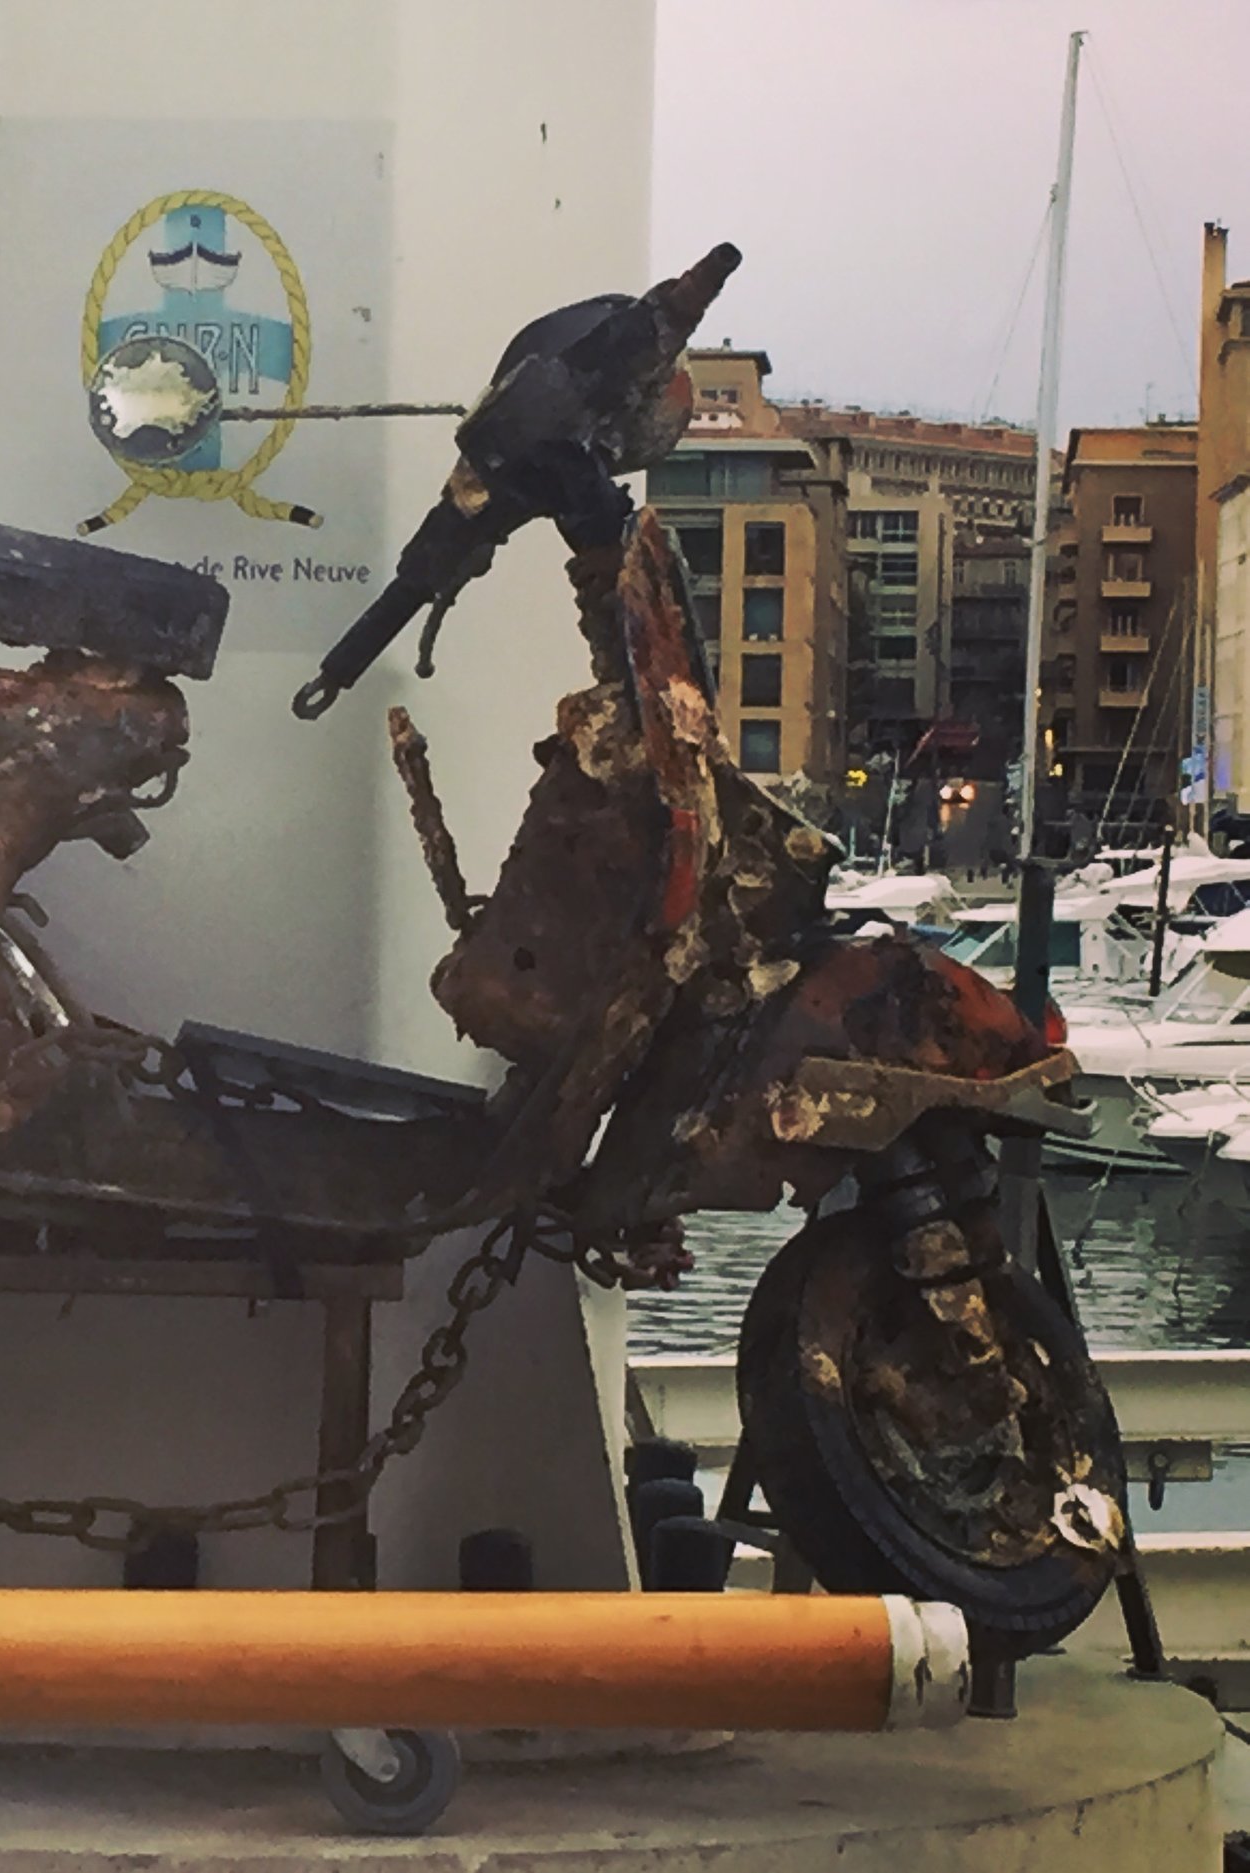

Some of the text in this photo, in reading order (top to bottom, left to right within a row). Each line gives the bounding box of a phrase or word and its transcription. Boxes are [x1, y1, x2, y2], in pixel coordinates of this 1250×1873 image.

[193, 554, 371, 584] de Rive Neuve
